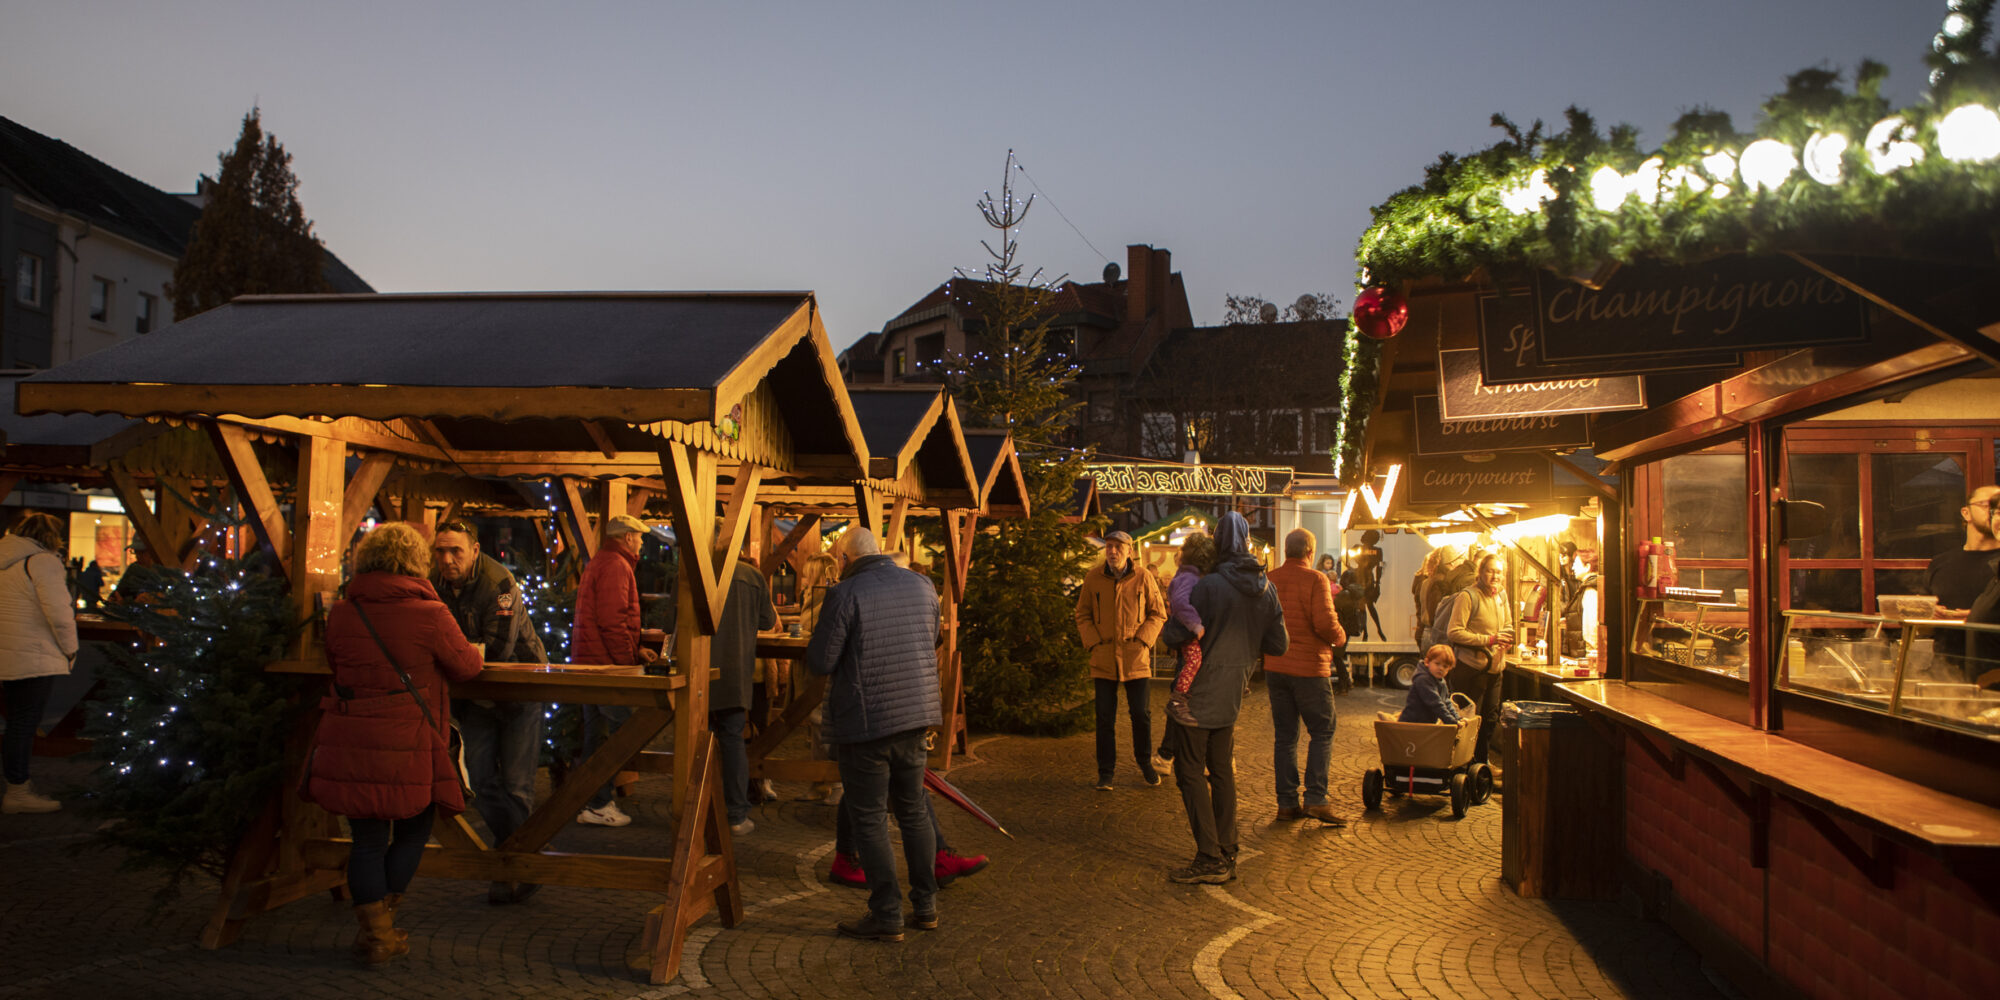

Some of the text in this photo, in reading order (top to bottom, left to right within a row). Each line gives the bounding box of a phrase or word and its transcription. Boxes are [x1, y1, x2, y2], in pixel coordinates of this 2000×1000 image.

[1549, 273, 1847, 335] Champignons
[1503, 323, 1536, 368] Sp
[1423, 467, 1536, 496] Currywurst
